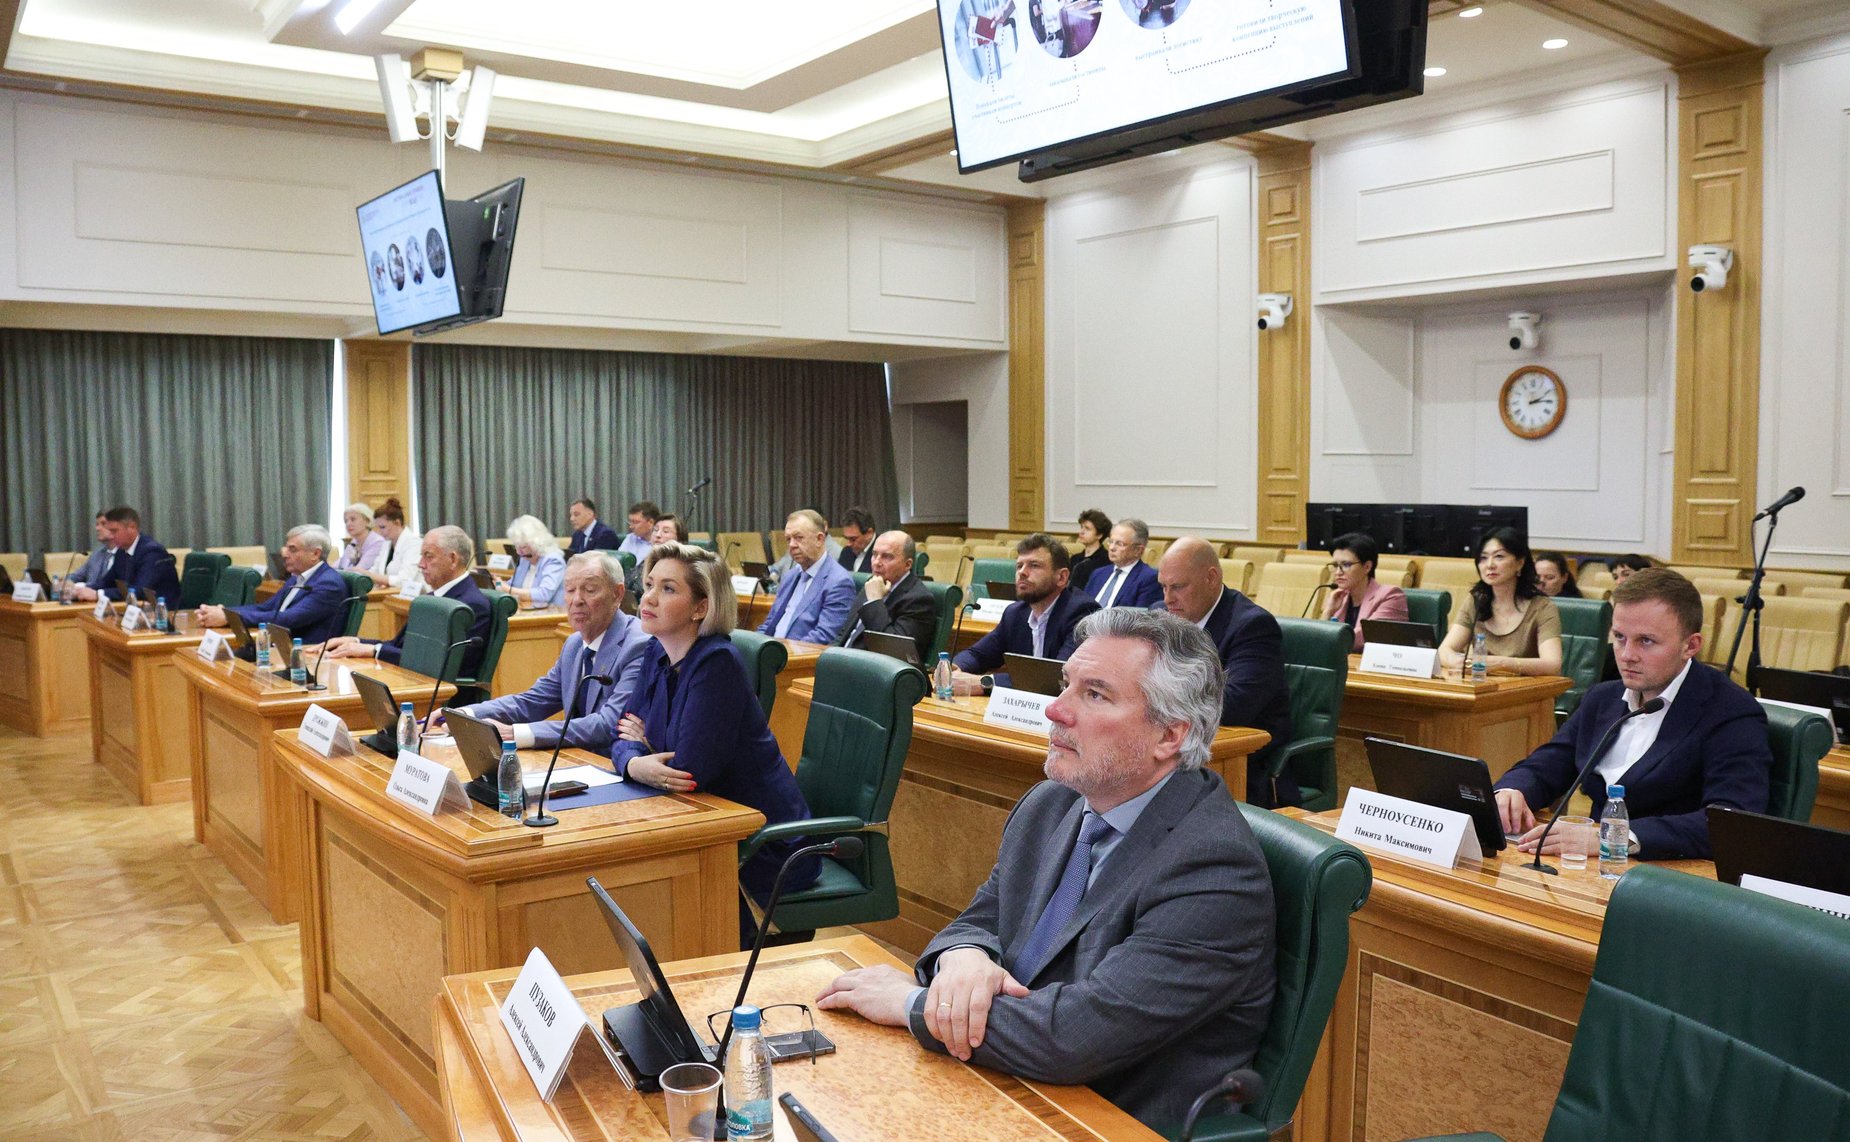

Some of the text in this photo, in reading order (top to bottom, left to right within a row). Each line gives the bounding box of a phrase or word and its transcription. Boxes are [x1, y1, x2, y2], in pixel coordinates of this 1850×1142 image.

[1003, 696, 1041, 711] ЗАХАРЫЧЕВ
[405, 763, 431, 783] МУРАТОВА
[1359, 802, 1444, 833] ЧЕРНОУСЕНКО
[1354, 826, 1433, 854] Никита Максимович
[528, 981, 557, 1028] ПУЗАКОВ
[509, 1003, 546, 1074] Алексей Александрович
